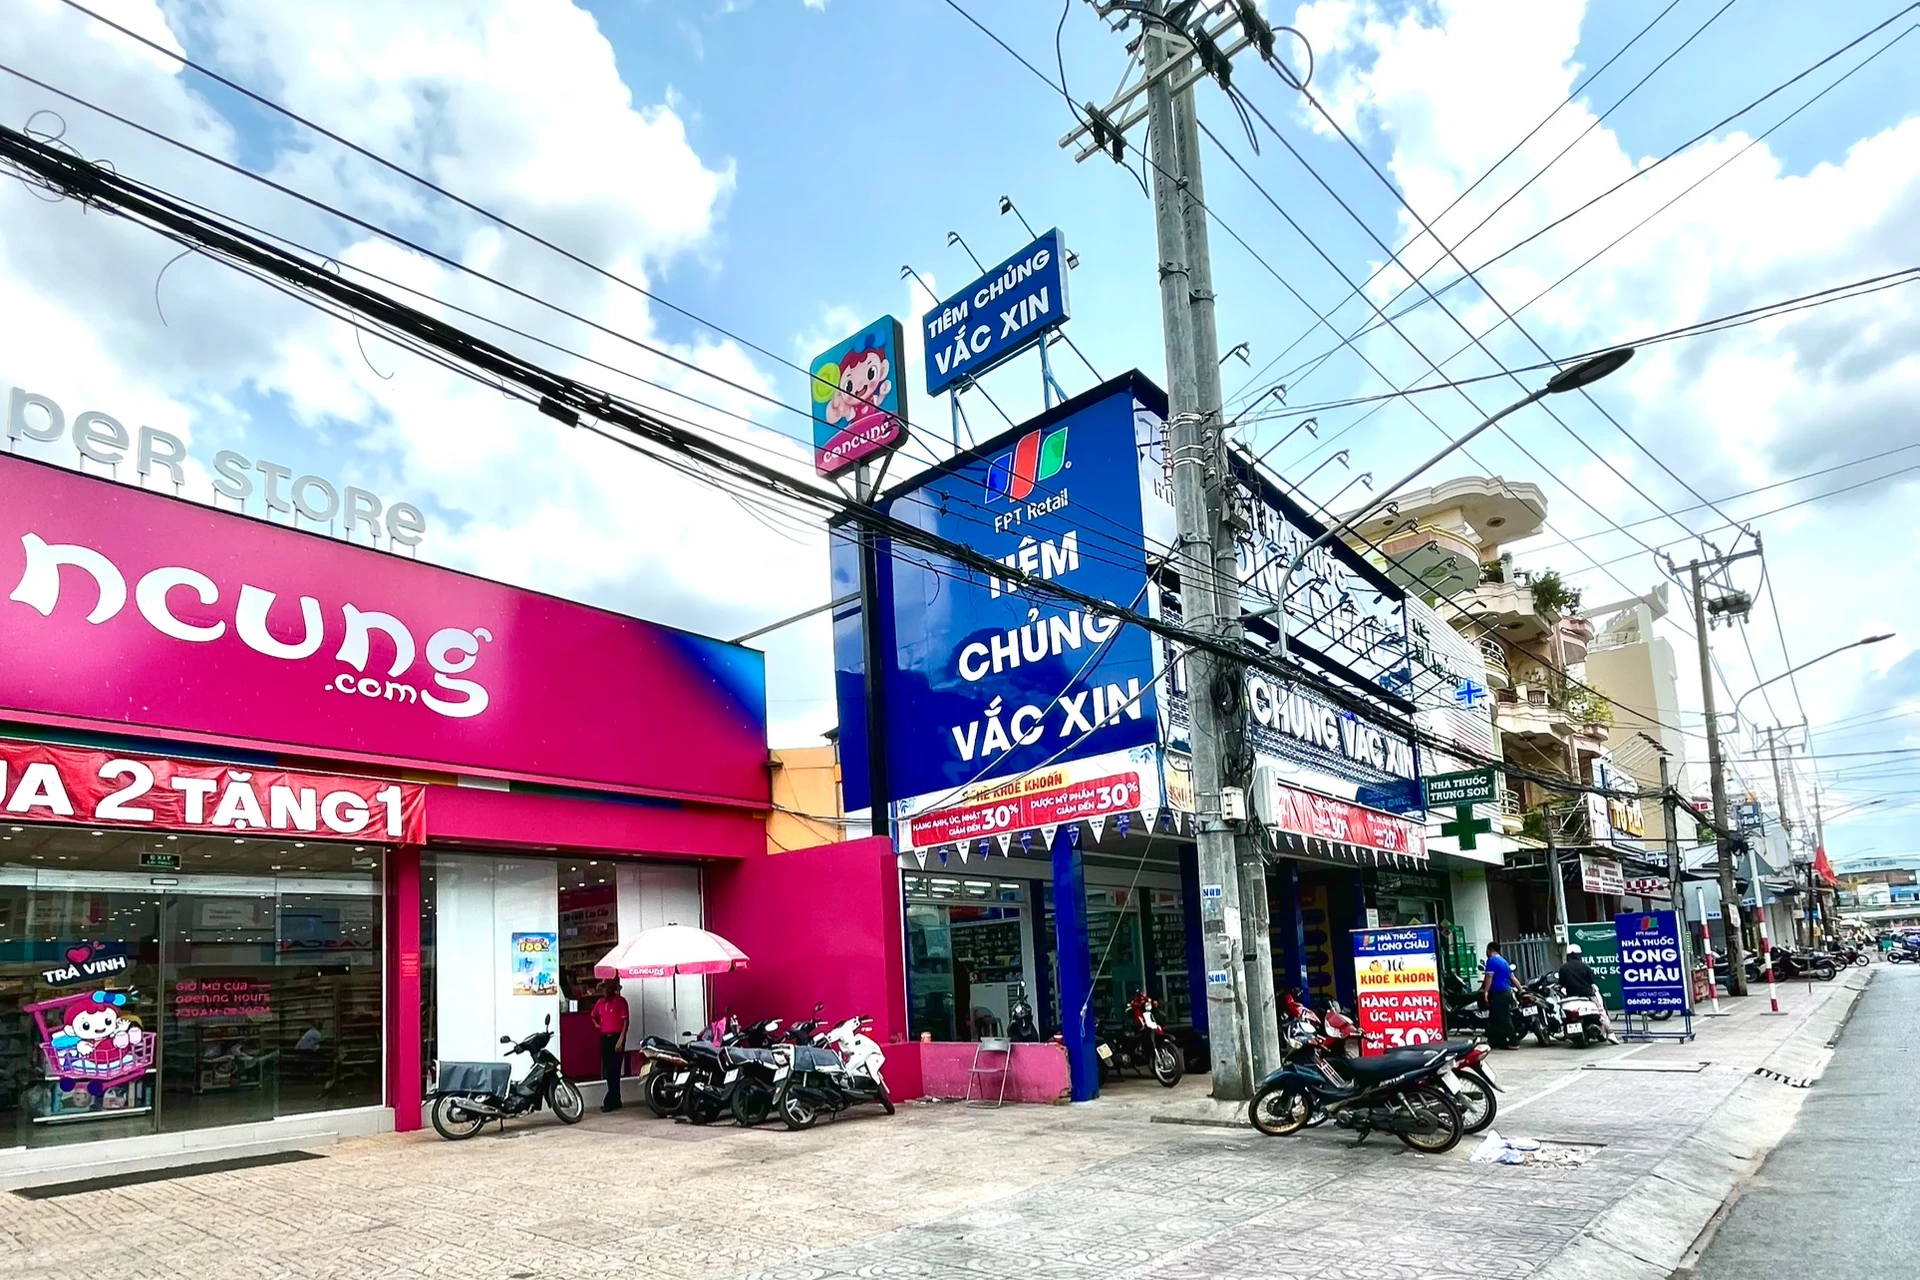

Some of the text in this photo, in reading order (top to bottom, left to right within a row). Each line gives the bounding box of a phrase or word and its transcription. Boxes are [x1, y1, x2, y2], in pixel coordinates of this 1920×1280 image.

[928, 248, 1051, 339] TIÊM CHỦNG
[934, 286, 1050, 376] VẮC XIN
[994, 488, 1069, 533] FPT Retail
[958, 602, 1122, 682] CHỦNG
[324, 673, 418, 705] .com
[952, 678, 1142, 761] VẮC XIN
[1386, 734, 1417, 781] XIN
[1430, 774, 1487, 790] NHÀ THUỐC
[95, 758, 155, 822] 2
[170, 770, 370, 834] TẶNG
[376, 785, 403, 837] 1
[1030, 796, 1055, 809] DƯỢC
[1096, 782, 1139, 809] 30%
[1430, 789, 1465, 801] TRUNG
[912, 818, 932, 831] HÀNG
[981, 803, 1019, 831] 30%
[1377, 931, 1417, 942] NHÀ THUỐC
[1377, 942, 1402, 951] LONG
[1404, 940, 1429, 950] CHÂU
[1621, 938, 1641, 947] NHÀ
[1642, 936, 1675, 946] THUỐC
[1622, 948, 1678, 963] LONG
[42, 956, 126, 983] TRÀ VINH
[1623, 964, 1680, 982] CHÂU
[1361, 993, 1438, 1009] HÀNG ANH,
[1657, 997, 1682, 1005] 22h00
[1369, 1008, 1434, 1024] ÚC, NHẬT
[1366, 1040, 1384, 1049] ĐẾN
